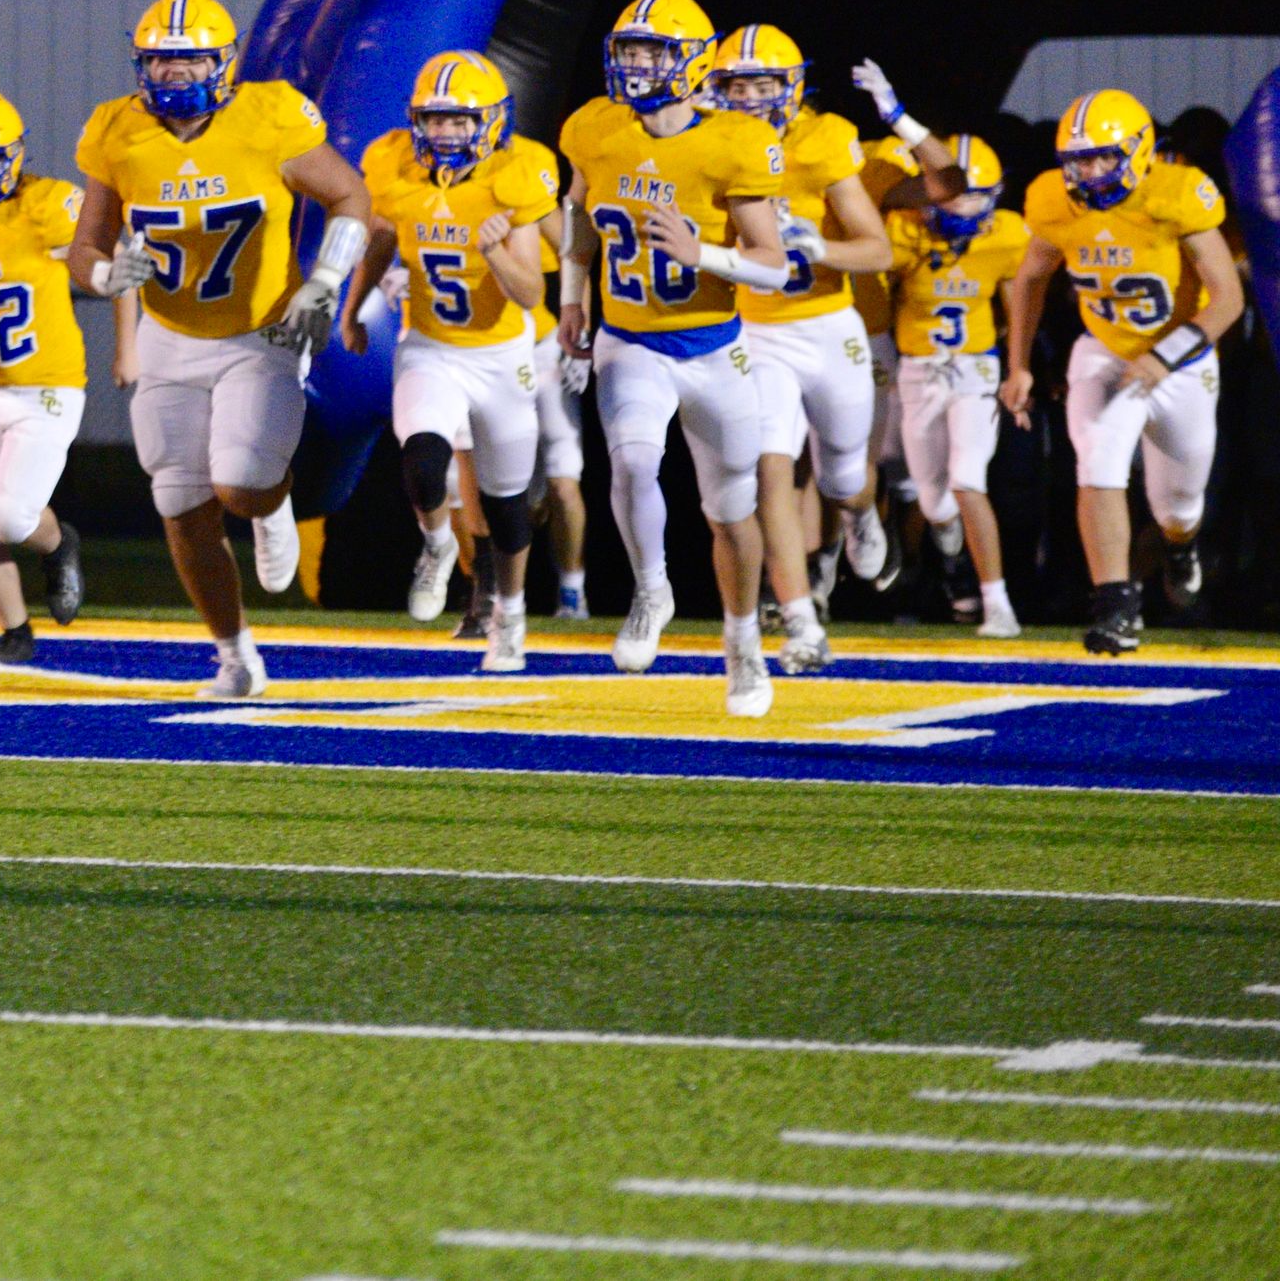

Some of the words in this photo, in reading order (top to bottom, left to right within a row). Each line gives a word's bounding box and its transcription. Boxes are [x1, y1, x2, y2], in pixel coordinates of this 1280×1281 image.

[159, 176, 228, 202] RAMS
[618, 174, 676, 204] RAMS
[415, 222, 469, 244] RAMS
[128, 196, 265, 302] 57
[1078, 246, 1133, 268] RAMS
[418, 248, 472, 327] 5
[928, 301, 969, 350] 3
